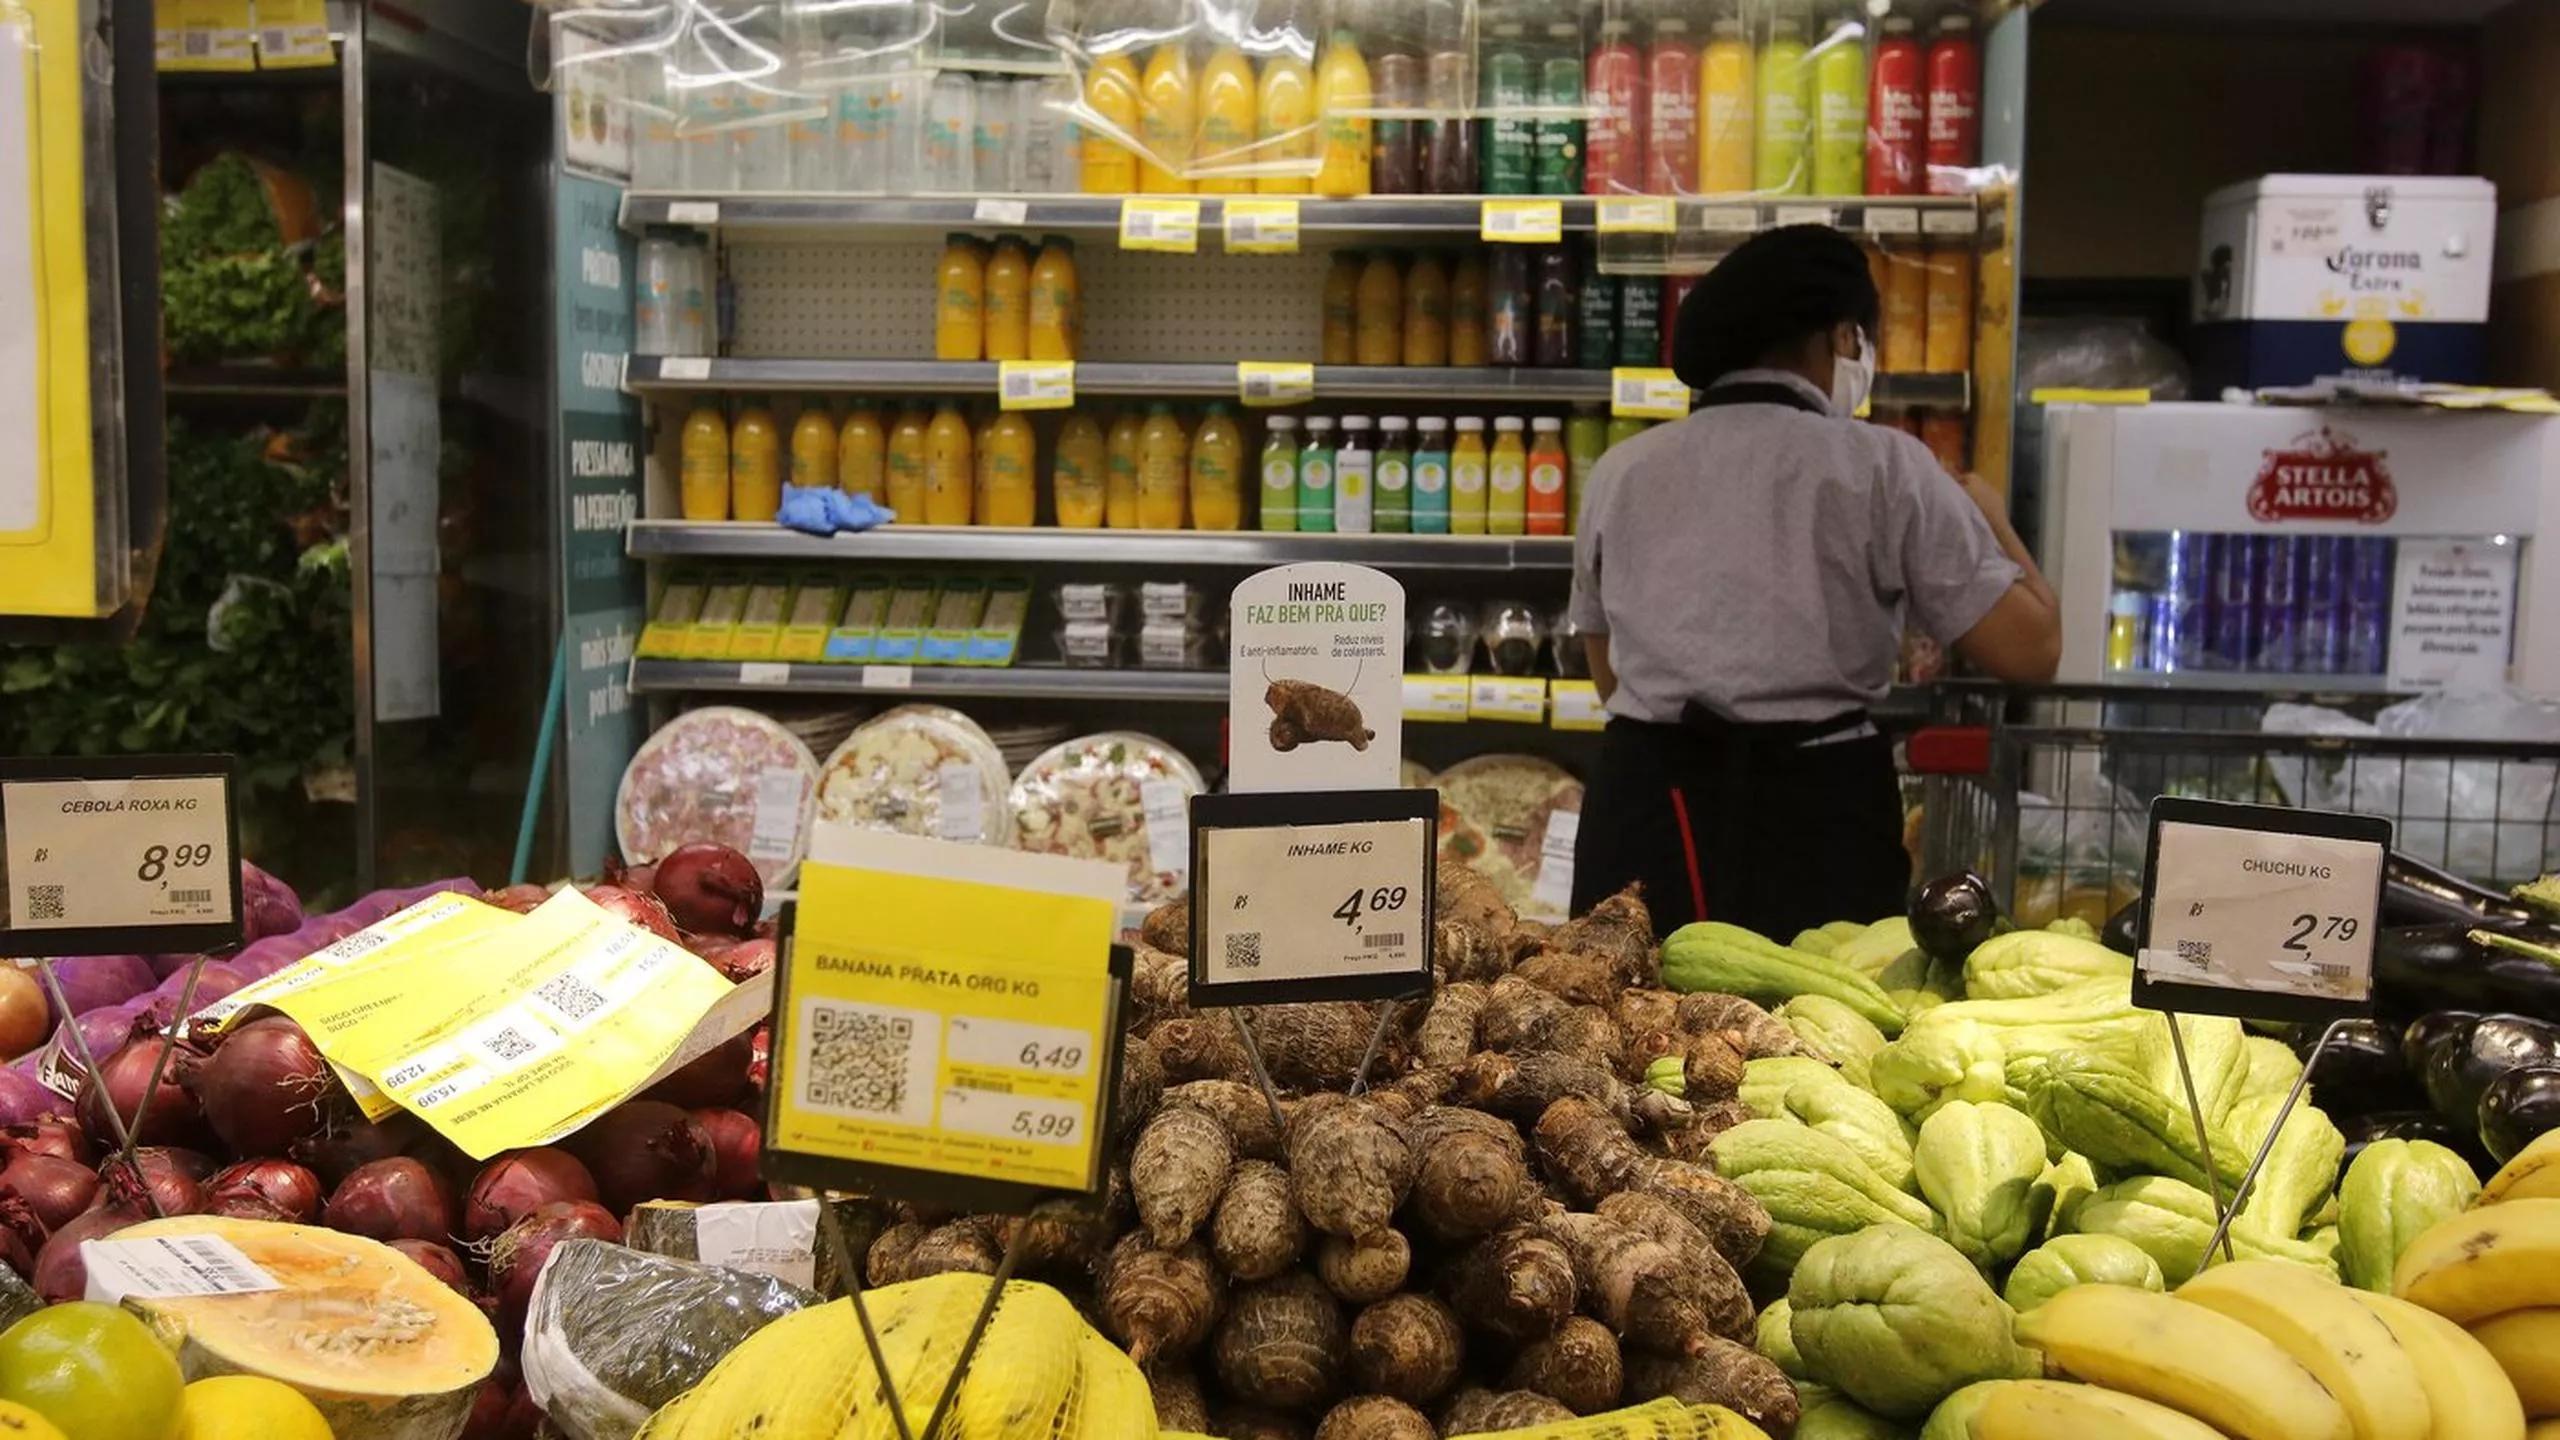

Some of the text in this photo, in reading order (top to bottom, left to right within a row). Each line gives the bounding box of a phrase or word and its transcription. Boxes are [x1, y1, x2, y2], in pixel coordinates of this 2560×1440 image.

[2276, 466, 2371, 486] STELLA
[2273, 487, 2371, 508] ARTOIS
[1288, 583, 1346, 602] INHAME
[1247, 602, 1387, 625] FAZ BEM PRA QUE?
[1331, 648, 1346, 658] de
[61, 798, 197, 814] CEBOLA ROXA KG
[1287, 840, 1374, 858] INHAME KG
[2242, 858, 2332, 879] CHUCHU KG
[815, 954, 1041, 998] BANANA PRATA ORG KG
[1019, 1041, 1083, 1069] 6,49
[1011, 1110, 1075, 1138] 5,99
